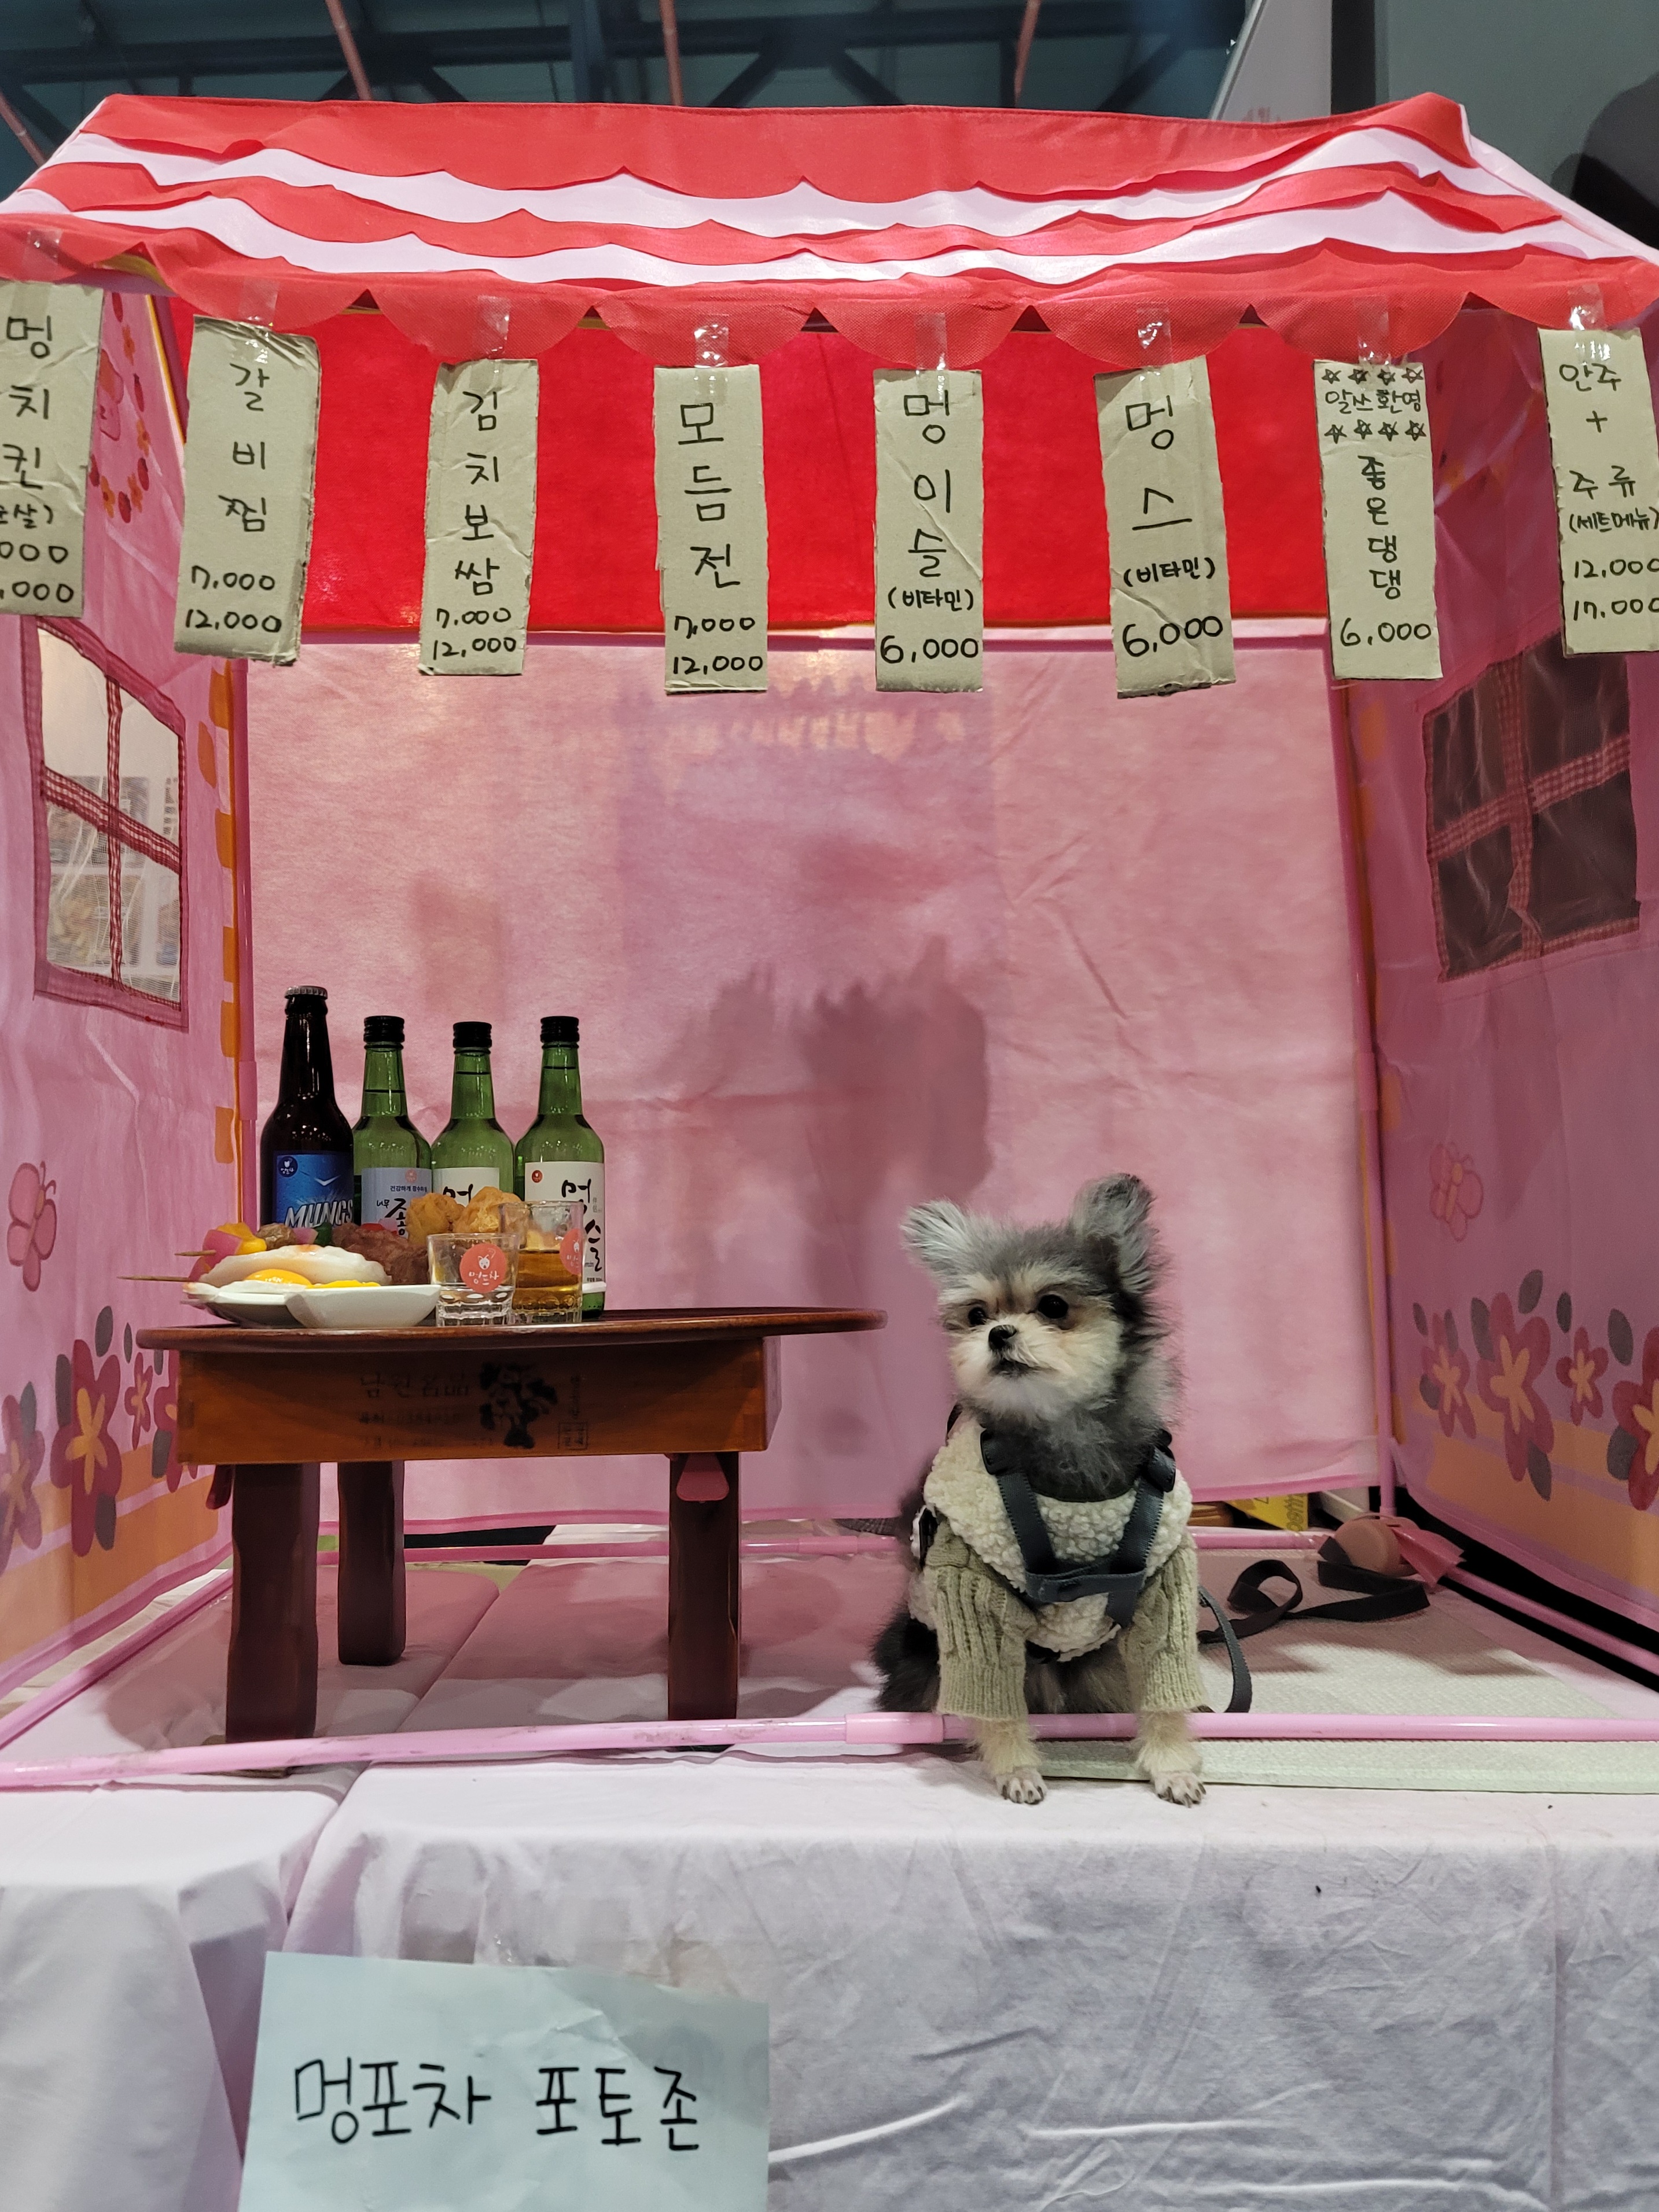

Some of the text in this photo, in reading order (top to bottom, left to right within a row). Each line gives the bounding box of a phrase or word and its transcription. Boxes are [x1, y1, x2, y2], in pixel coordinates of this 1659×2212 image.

[1559, 361, 1621, 392] 안주
[218, 364, 270, 532] 갈비찜
[1125, 395, 1193, 531] 멍스
[453, 389, 505, 595] 김치보쌈
[678, 403, 741, 588] 모듬전
[904, 389, 955, 577] 멍이슬
[1569, 465, 1636, 499] 주류
[1358, 455, 1401, 599] 좋은댕댕
[1569, 506, 1659, 533] (세트메뉴)
[1124, 557, 1215, 587] (비타민)
[888, 587, 973, 612] (비타민)
[185, 609, 282, 633] 12,000
[1123, 613, 1223, 657] 6,000
[1340, 617, 1431, 646] 6,000
[673, 656, 763, 675] 12,000
[880, 635, 979, 664] 6,000
[295, 2056, 699, 2151] 멍포차 포토존
